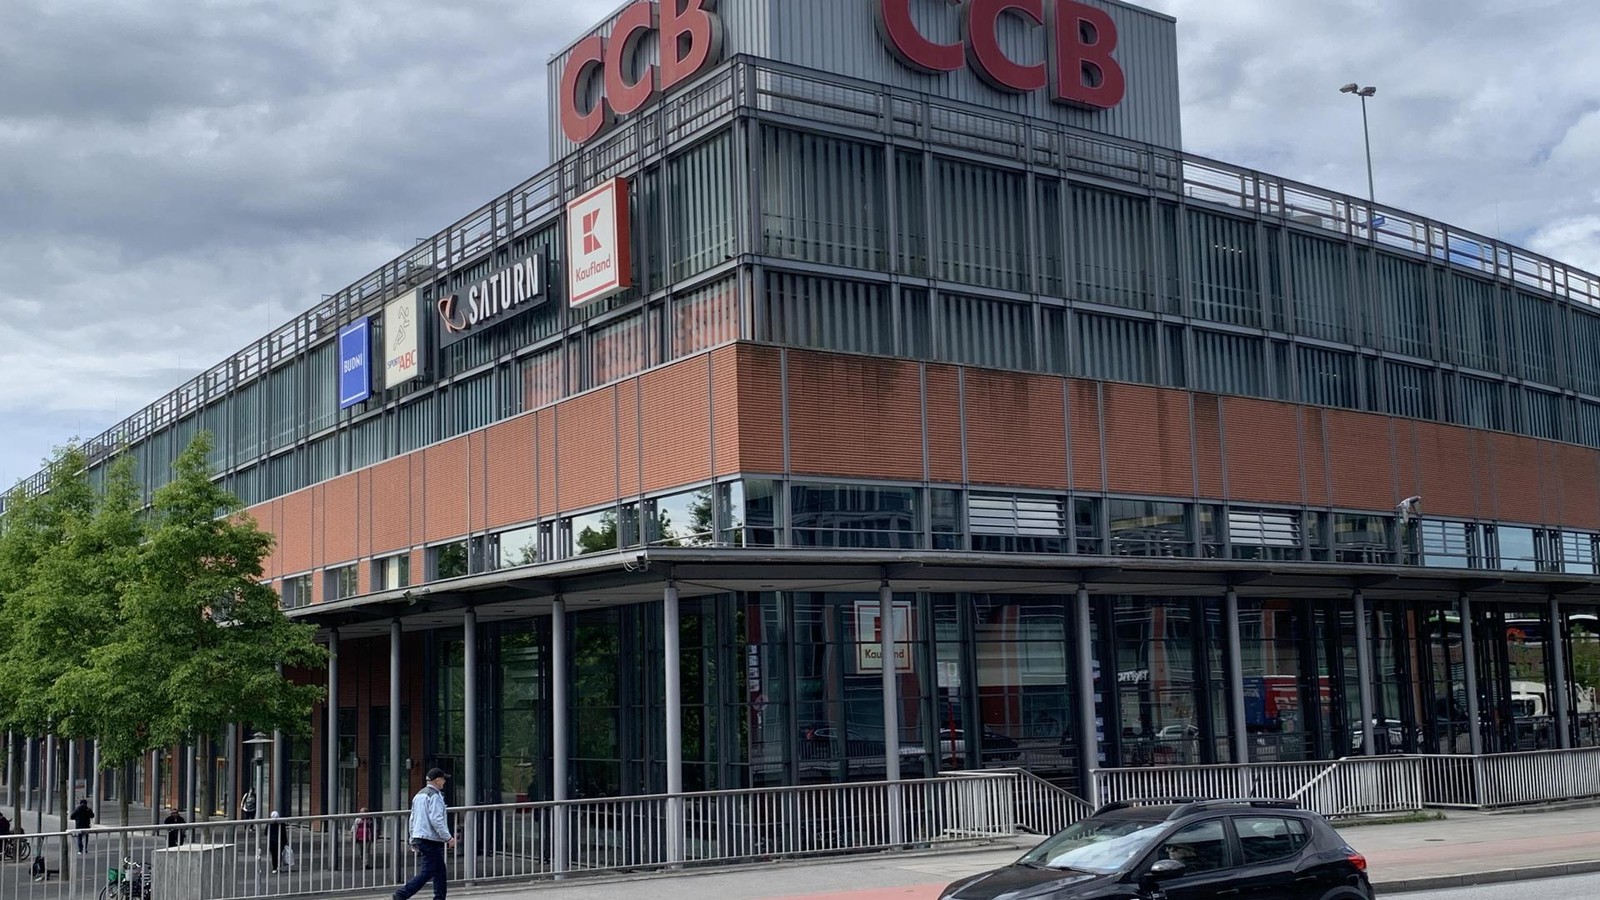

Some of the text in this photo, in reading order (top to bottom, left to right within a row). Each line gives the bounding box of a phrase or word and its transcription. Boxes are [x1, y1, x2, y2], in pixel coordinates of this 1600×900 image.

[877, 0, 1126, 110] CCB
[560, 0, 719, 144] CCB
[575, 254, 611, 283] Kaufland
[468, 253, 539, 325] SATURN
[344, 353, 363, 374] BUDNI
[399, 349, 417, 372] ABC
[865, 649, 905, 659] Kaund
